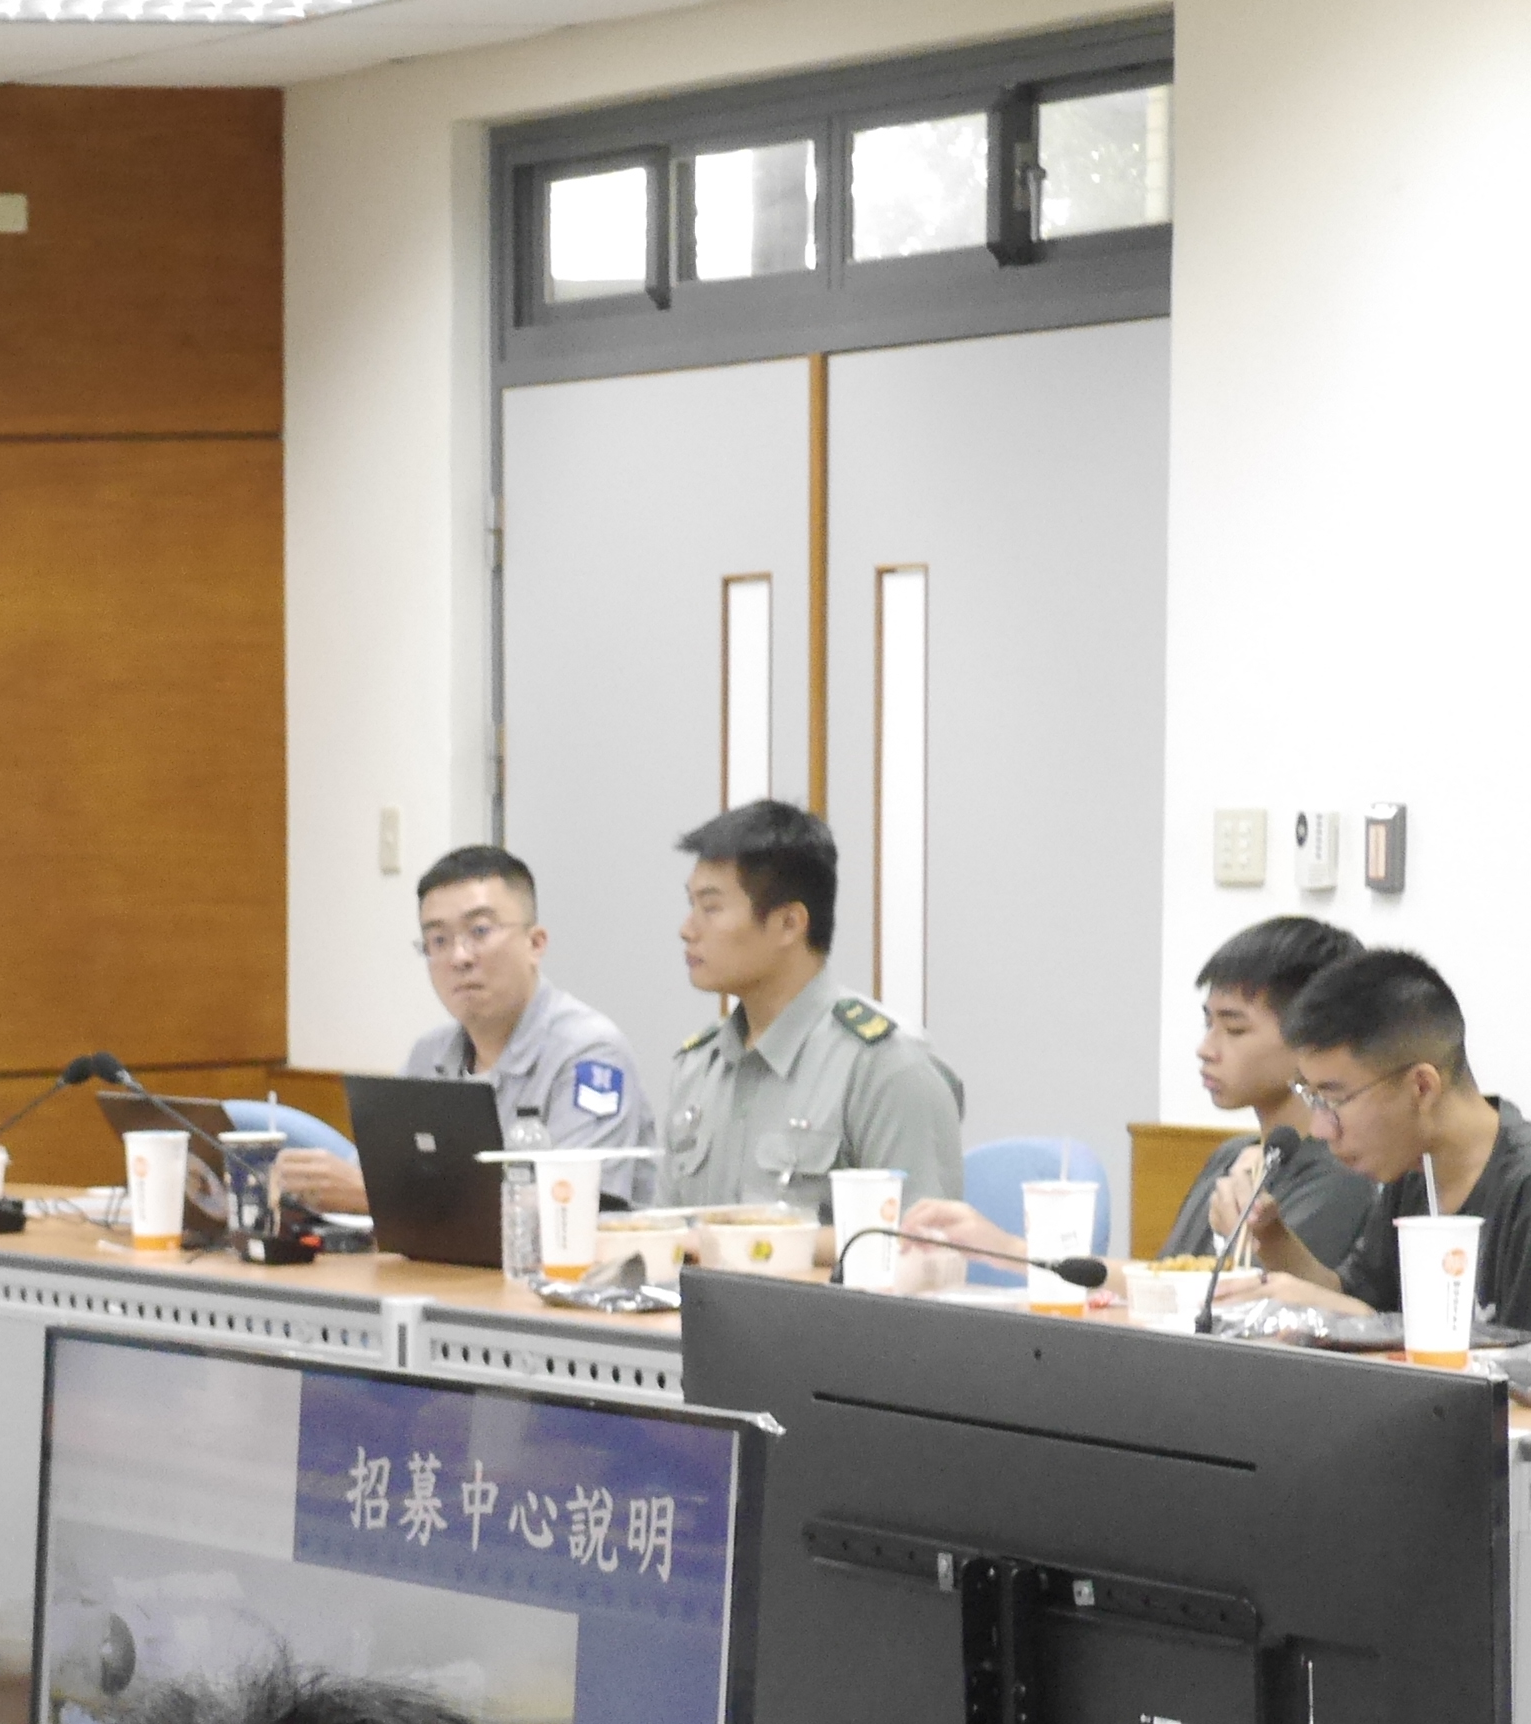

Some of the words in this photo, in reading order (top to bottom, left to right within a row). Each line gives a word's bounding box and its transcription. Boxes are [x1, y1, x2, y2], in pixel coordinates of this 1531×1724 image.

[345, 1445, 676, 1583] 招募中心說明
